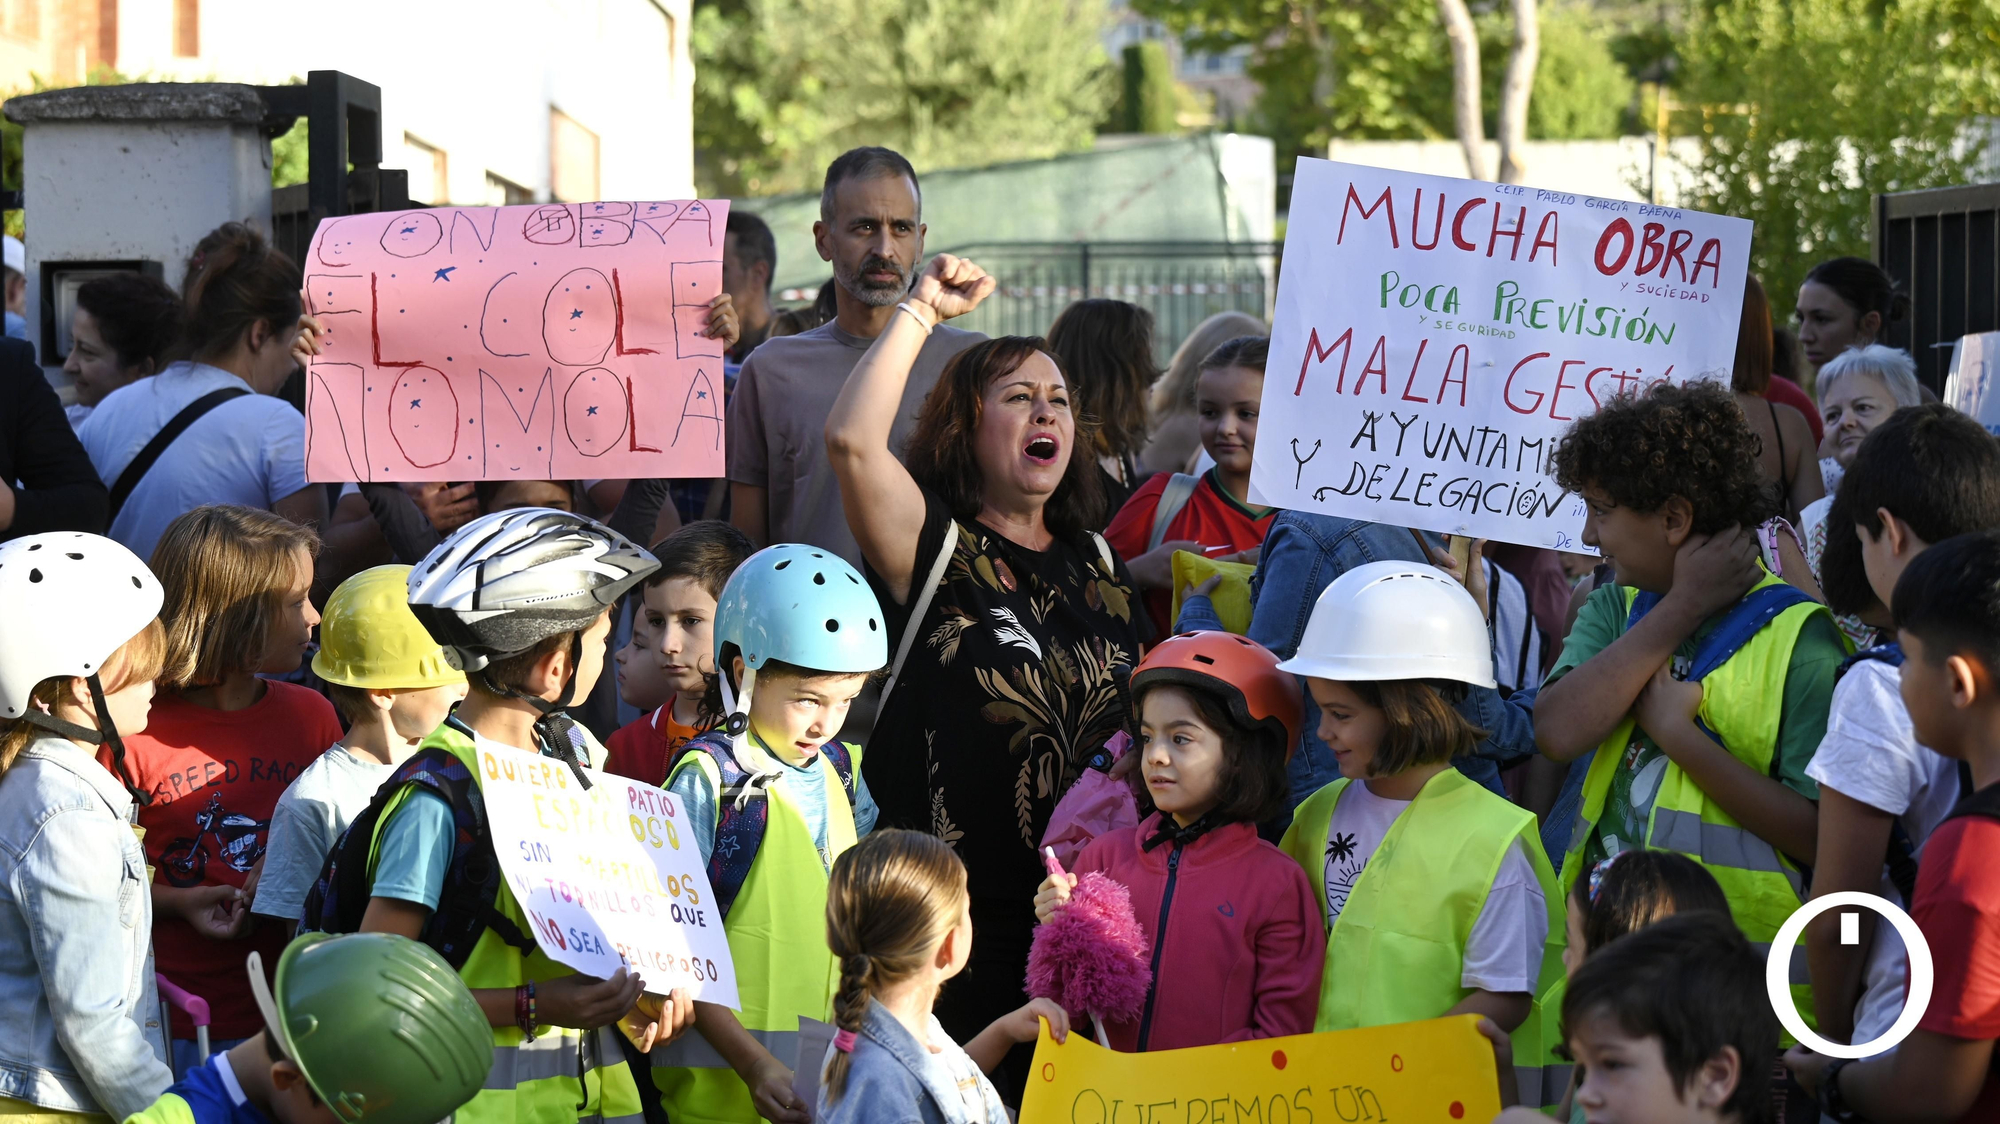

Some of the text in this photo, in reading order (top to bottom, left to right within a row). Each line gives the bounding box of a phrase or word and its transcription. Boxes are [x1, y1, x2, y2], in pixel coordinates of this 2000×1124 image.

[317, 199, 715, 268] CON OBRA
[1336, 182, 1722, 289] MUCHA OBRA
[1495, 184, 1682, 220] C.E.I.P. PABLO GARCÍA BAENA
[306, 260, 725, 370] EL COLE
[1380, 270, 1462, 316] POCA
[1293, 326, 1470, 409] MALA
[1290, 437, 1322, 491] Y
[1350, 410, 1557, 477] AYUNTAMi
[157, 757, 306, 807] SPEED RAC
[627, 785, 676, 818] PATIO
[514, 873, 708, 928] NI TORNILLOS QUE
[519, 839, 700, 906] SIN MARTILLOS
[529, 907, 719, 983] NO SEA PELIGROSO
